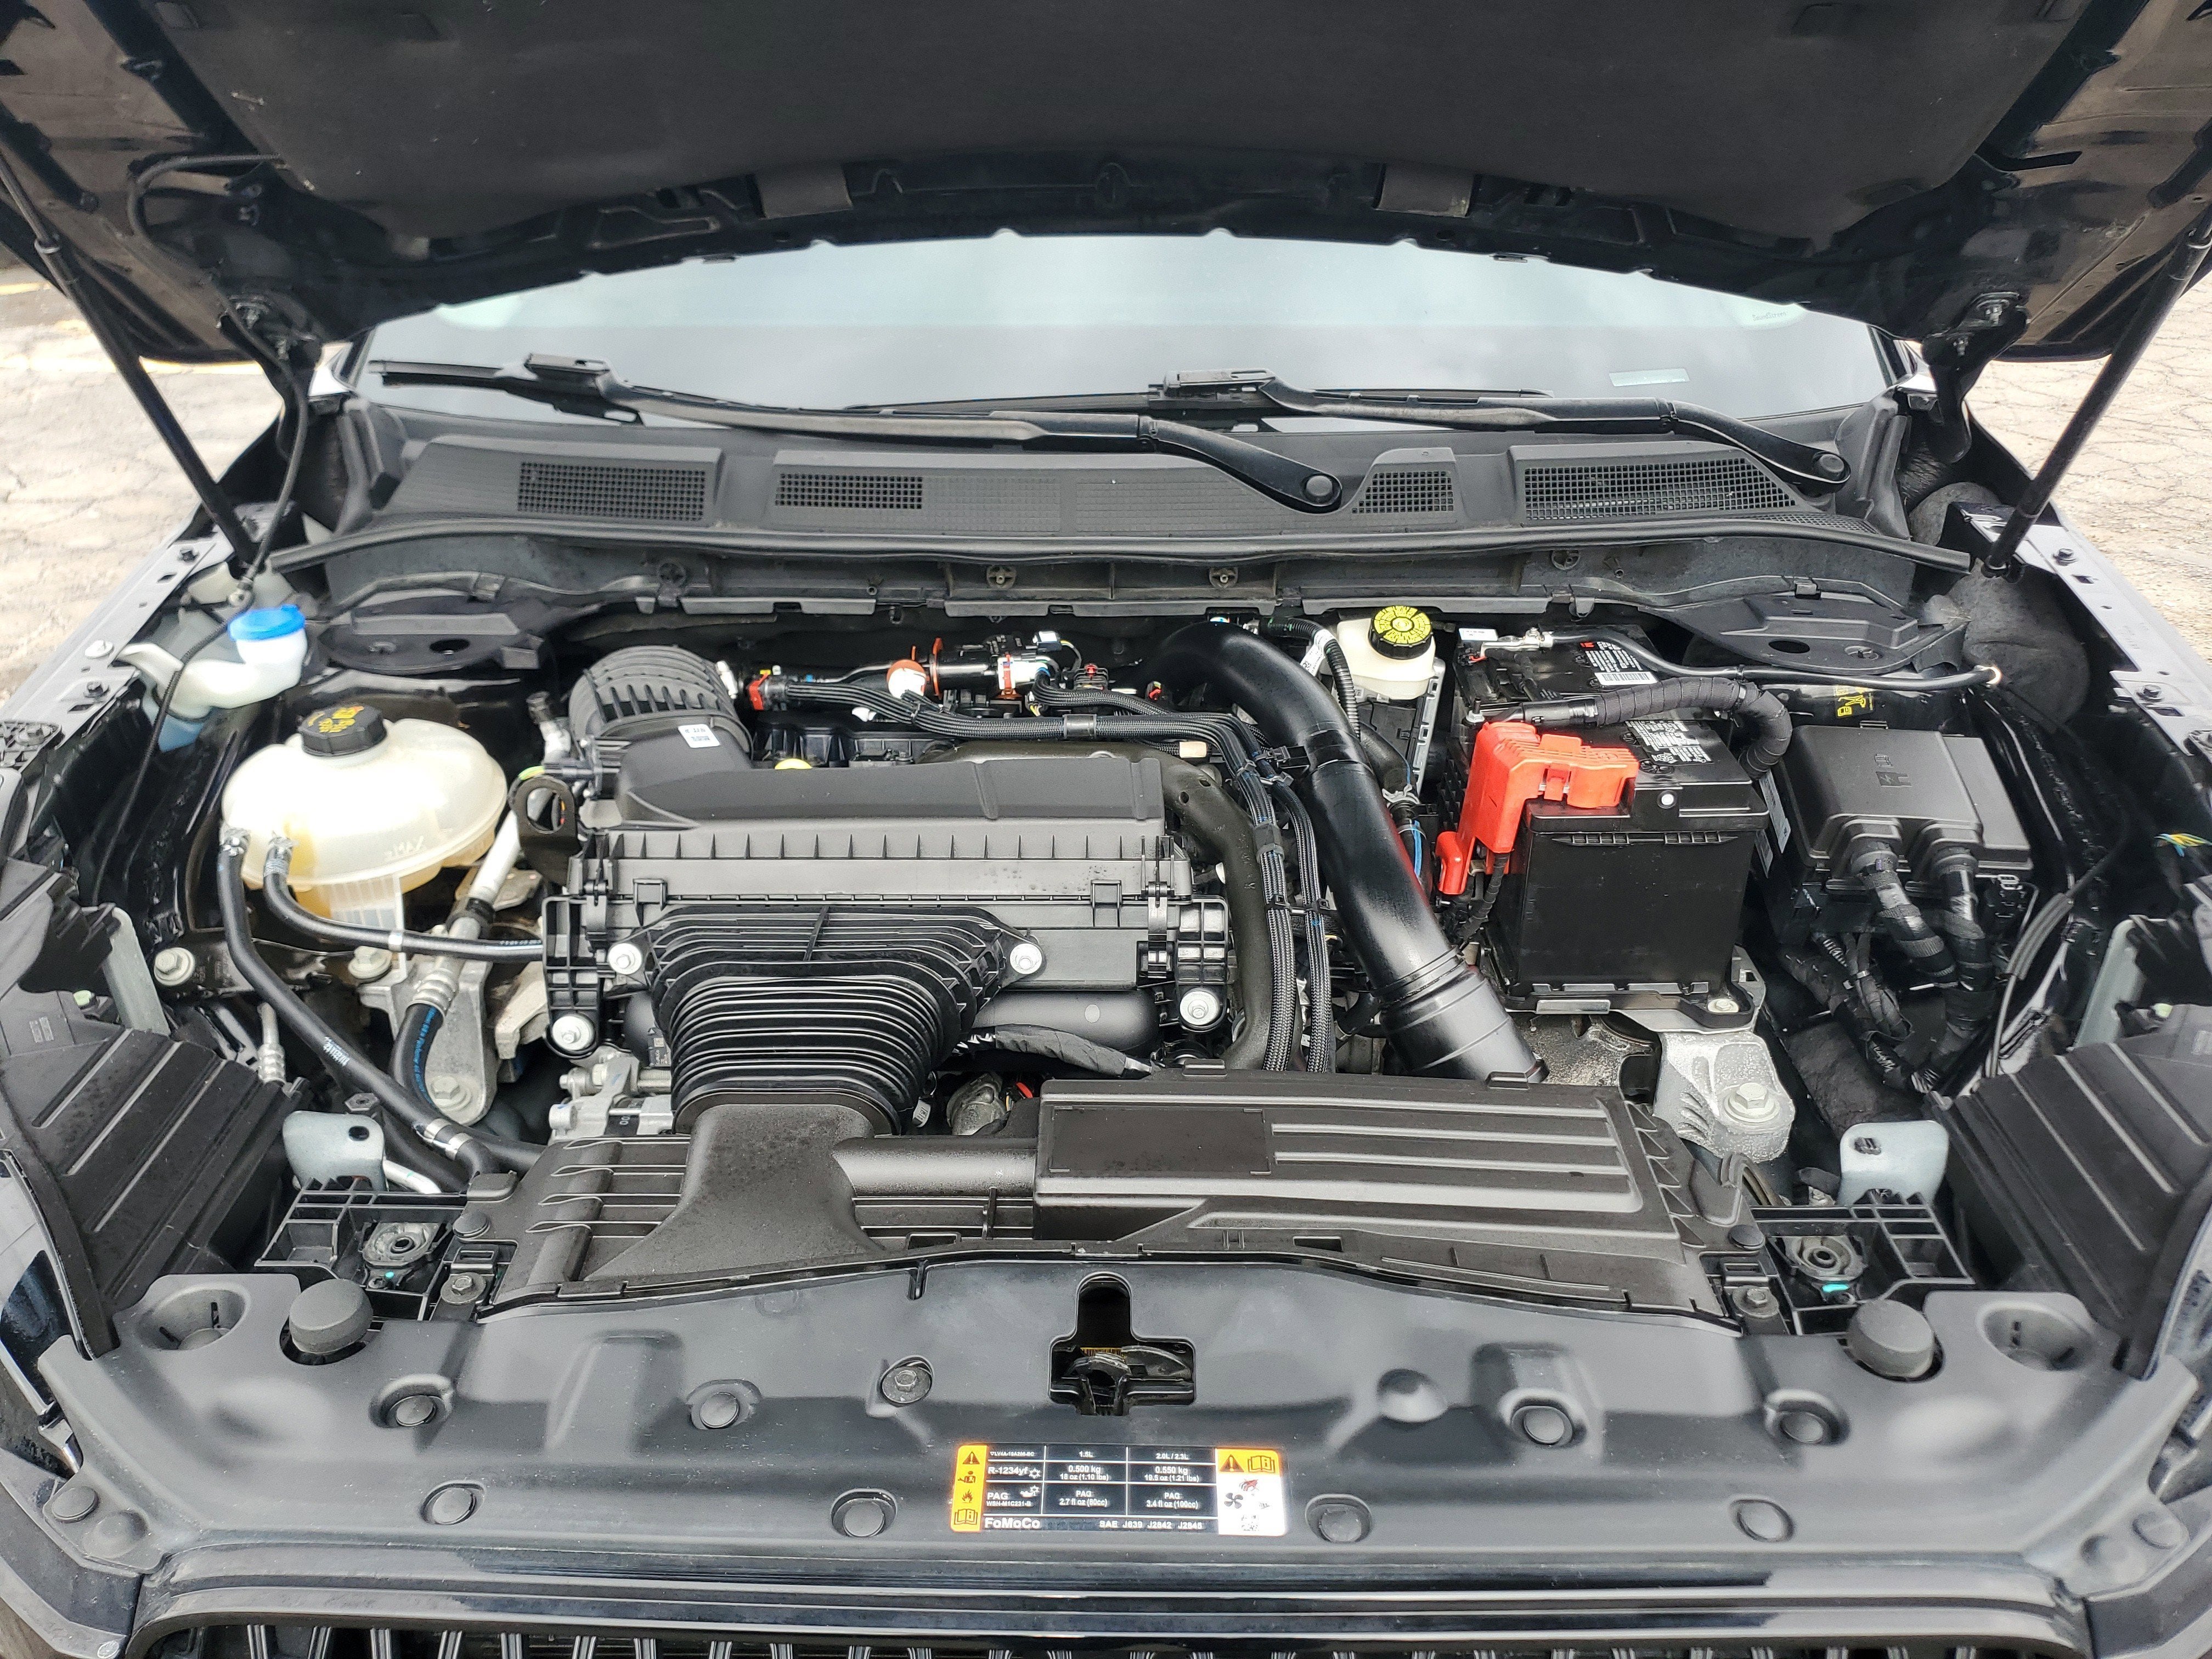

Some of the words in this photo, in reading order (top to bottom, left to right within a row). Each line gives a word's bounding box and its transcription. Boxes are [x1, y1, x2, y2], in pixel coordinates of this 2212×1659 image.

[988, 1467, 1029, 1476] R-1234yf
[1091, 1465, 1101, 1474] kg
[1178, 1466, 1188, 1475] kg
[1087, 1498, 1108, 1507] (80cc)
[1174, 1500, 1198, 1509] (100cc)
[985, 1517, 1041, 1528] FoMoCo
